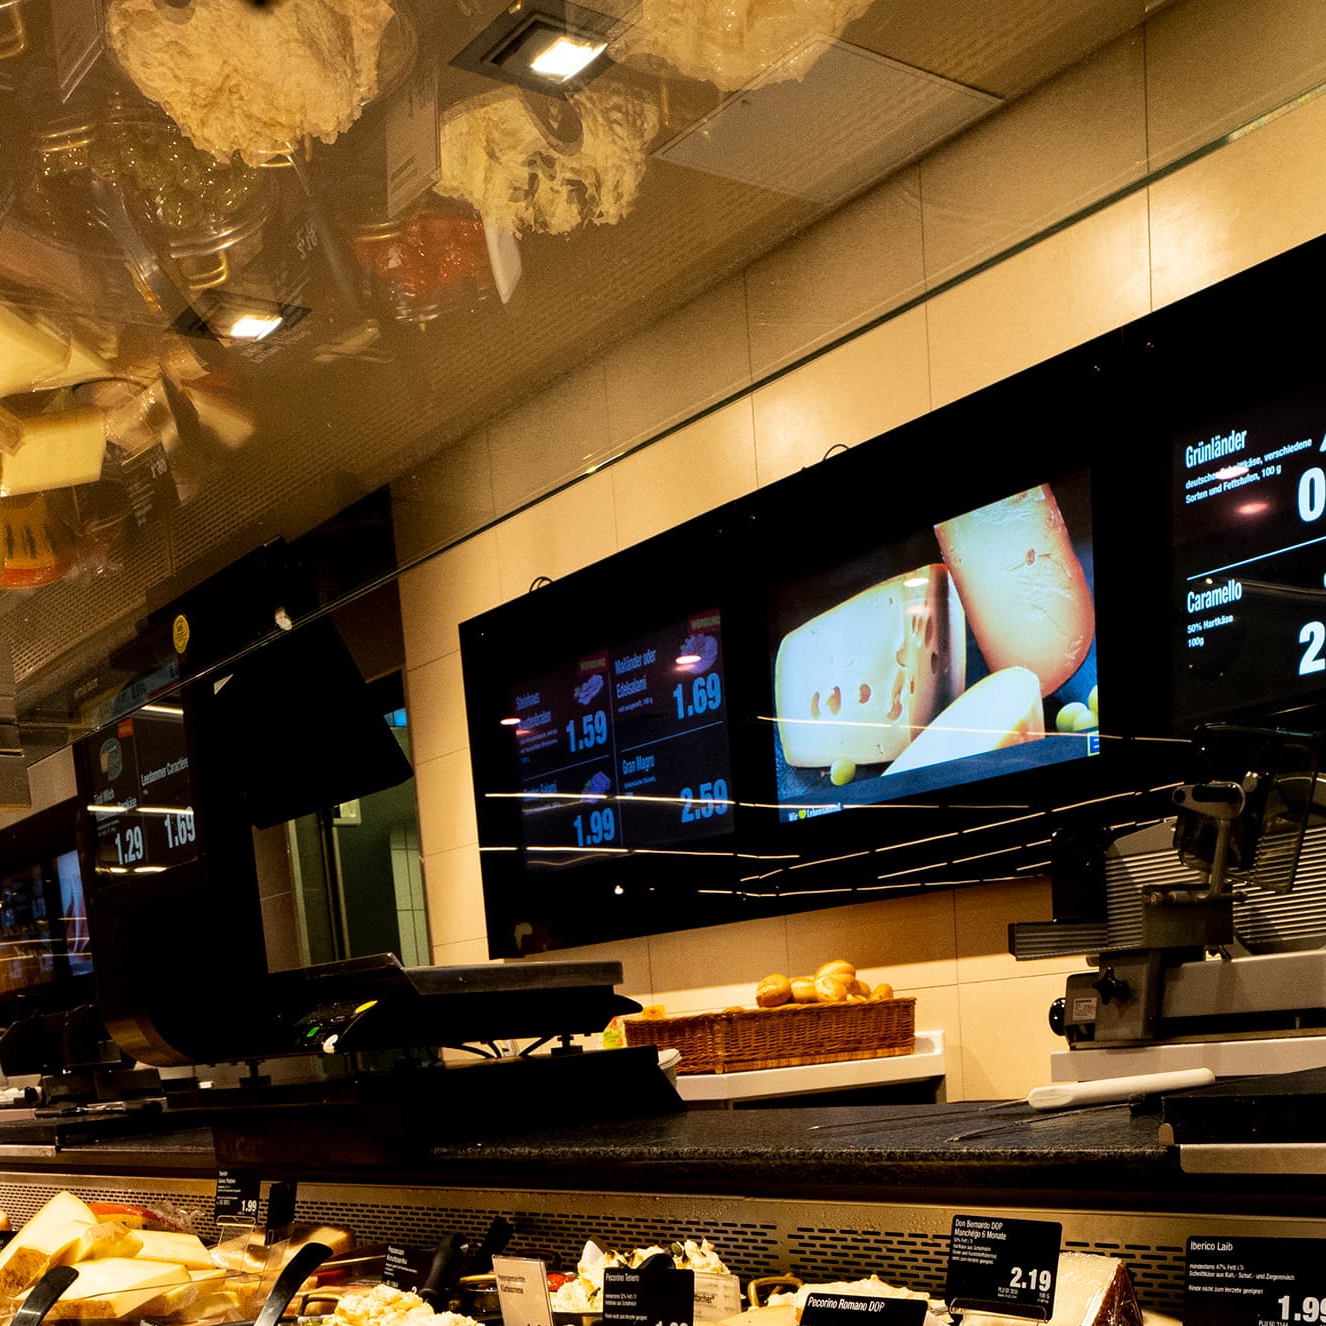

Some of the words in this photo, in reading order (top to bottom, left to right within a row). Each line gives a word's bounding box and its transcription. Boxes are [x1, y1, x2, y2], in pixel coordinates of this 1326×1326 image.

[1185, 429, 1247, 468] Grünländer
[1185, 472, 1220, 489] deutsche
[1264, 439, 1312, 464] verschiedene
[1186, 489, 1208, 504] Sorten
[1209, 483, 1222, 496] und
[1223, 473, 1260, 490] Fettstufen,
[1261, 466, 1275, 478] 100
[1187, 579, 1242, 614] Caramello
[1187, 621, 1202, 634] 50%
[1203, 614, 1234, 630] Hartkäse
[1187, 637, 1204, 648] 100g
[673, 673, 721, 720] 1.69
[566, 710, 607, 752] 1.59
[680, 779, 728, 824] 2.59
[115, 826, 143, 865] 1.29
[164, 806, 195, 848] 1.69
[574, 808, 615, 847] 1.99
[241, 1200, 257, 1213] 1.99
[1190, 1241, 1215, 1251] Iberico
[1217, 1242, 1233, 1251] Laib
[1010, 1267, 1051, 1292] 2.19
[808, 1297, 837, 1309] Pecorino
[838, 1298, 868, 1312] Romano
[868, 1301, 885, 1312] DOP
